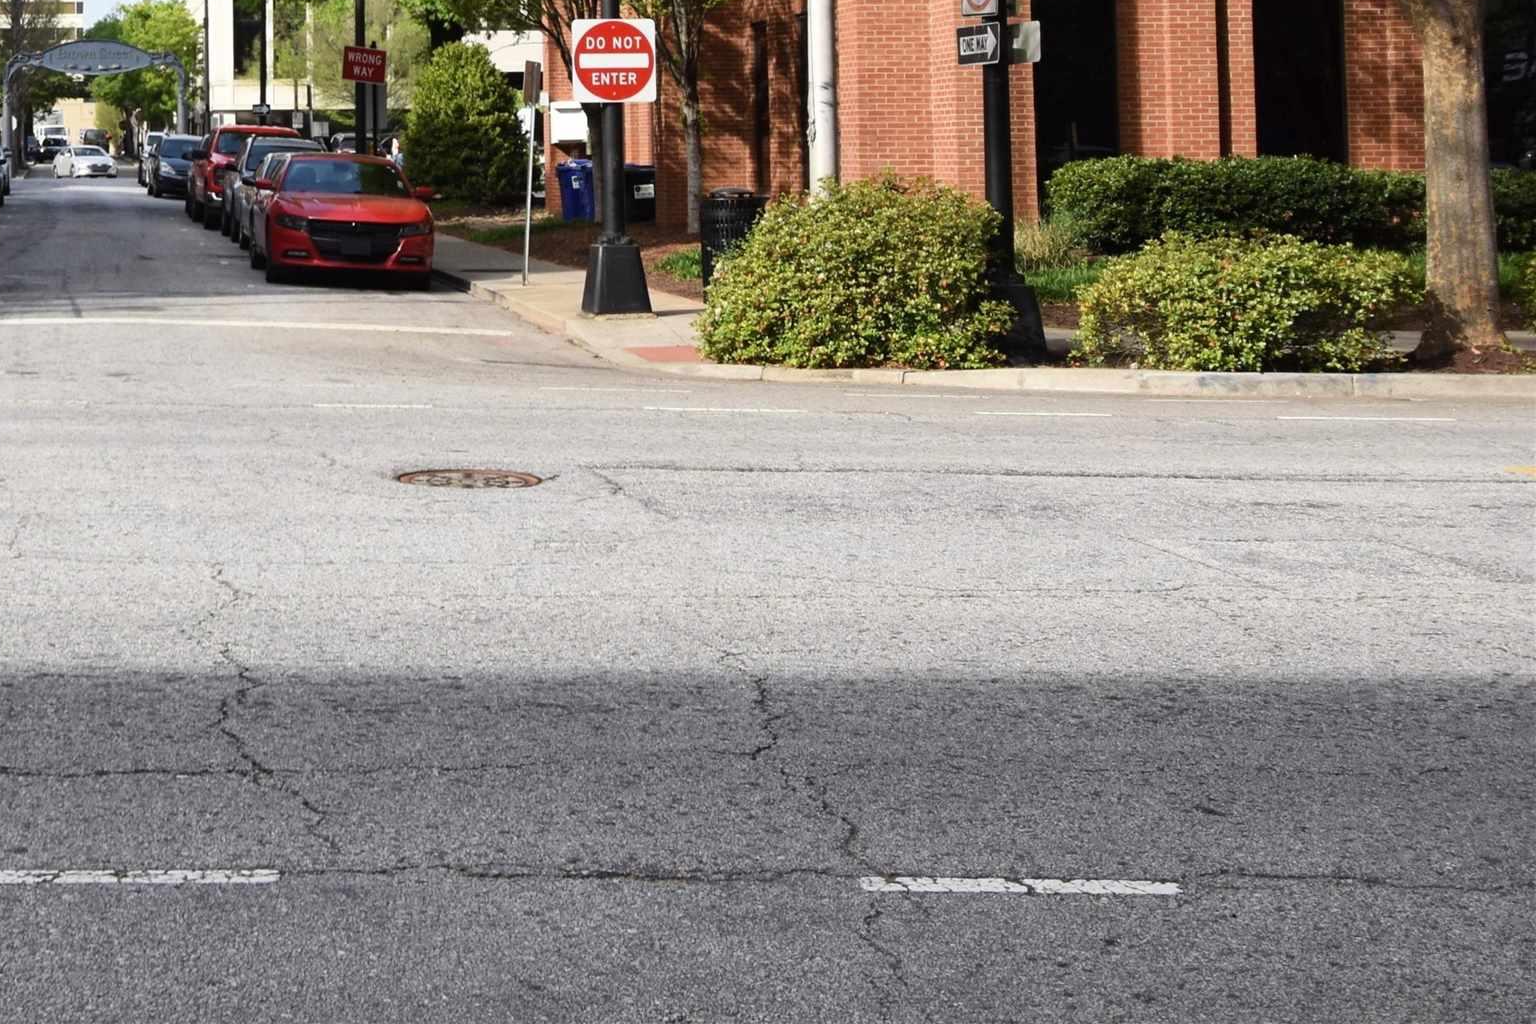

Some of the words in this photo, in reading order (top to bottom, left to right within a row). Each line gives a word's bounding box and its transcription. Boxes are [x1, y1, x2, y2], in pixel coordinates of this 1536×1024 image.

[585, 36, 606, 50] DO
[612, 36, 642, 50] NOT
[962, 38, 975, 53] ONE
[976, 36, 988, 50] WAY
[348, 51, 383, 65] WRONG
[353, 65, 375, 78] WAY
[591, 72, 638, 86] ENTER
